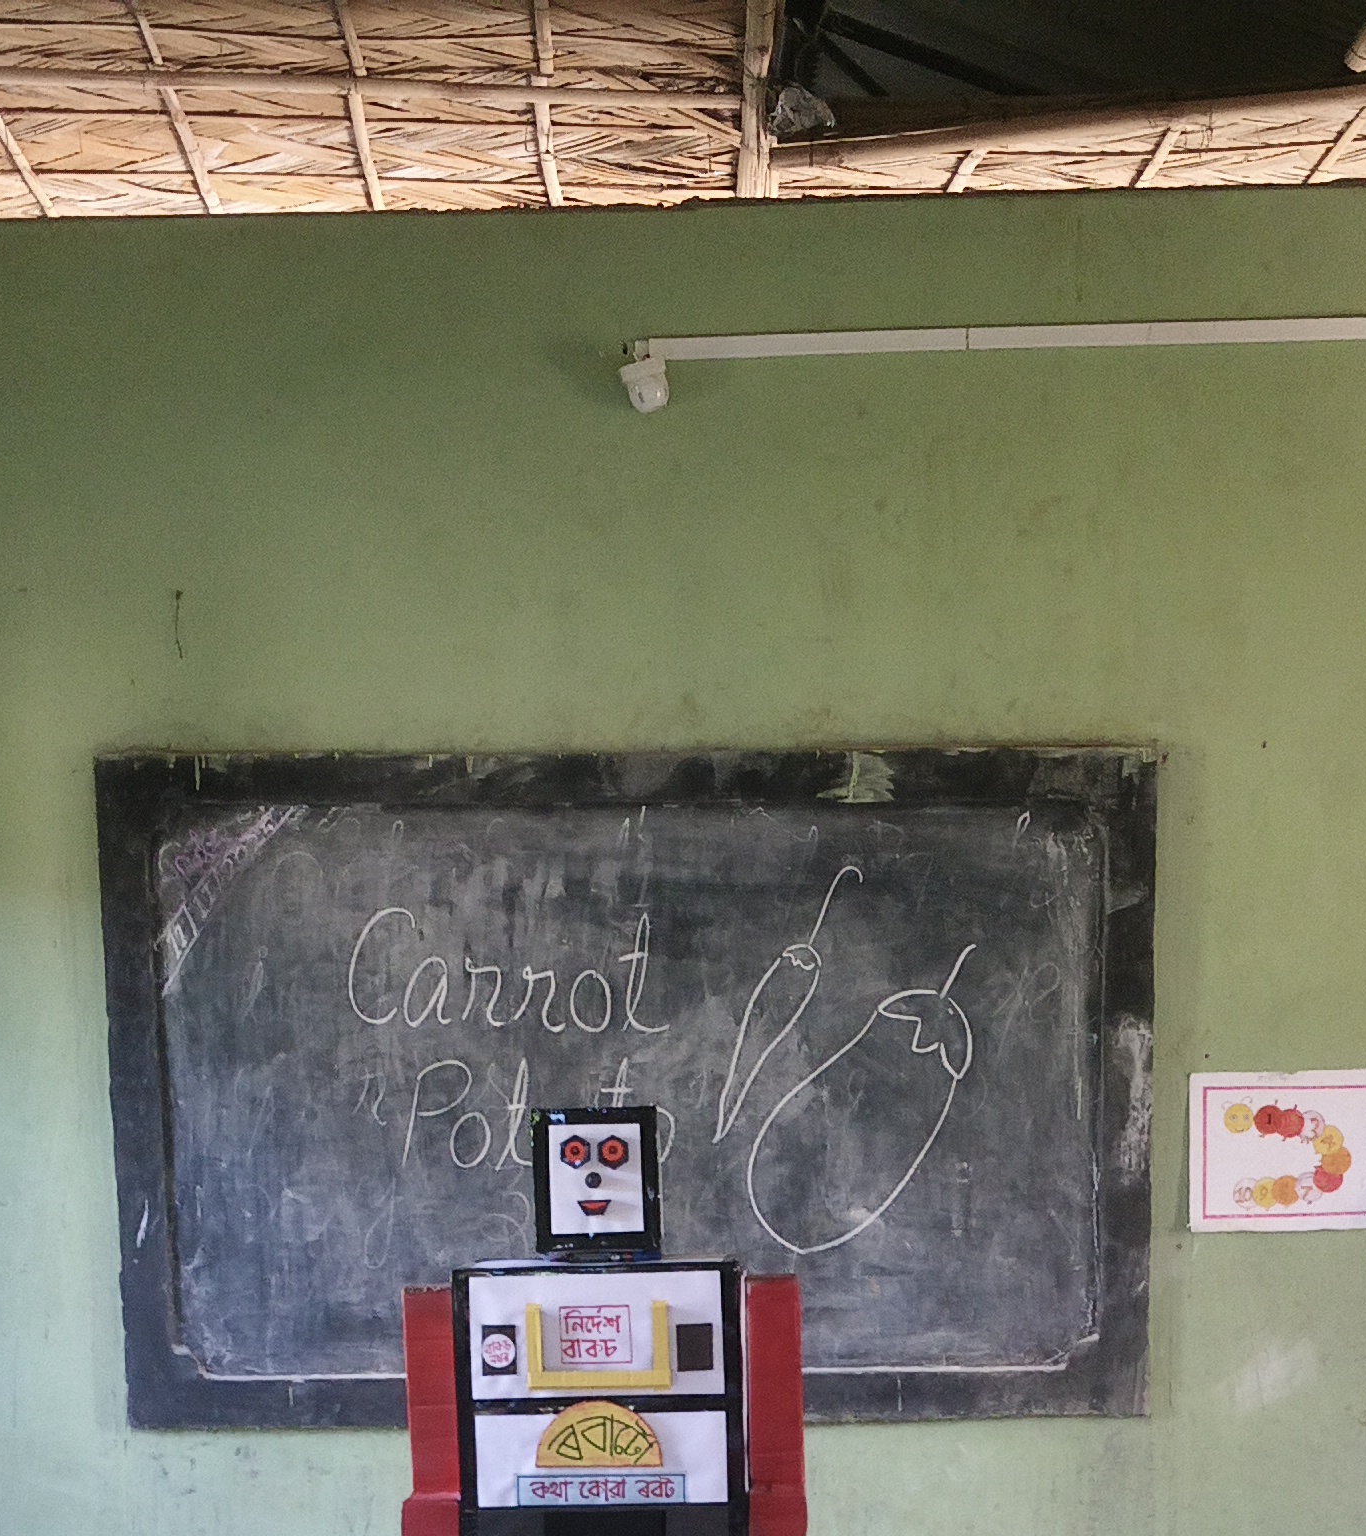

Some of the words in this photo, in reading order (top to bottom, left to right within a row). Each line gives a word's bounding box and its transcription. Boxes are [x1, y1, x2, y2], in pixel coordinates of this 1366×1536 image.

[348, 906, 671, 1033] Carrot
[402, 1056, 676, 1172] Pott
[1265, 1112, 1273, 1125] 1
[1300, 1185, 1314, 1200] 7
[560, 1337, 618, 1358] বাকচ
[529, 1478, 573, 1502] কথা
